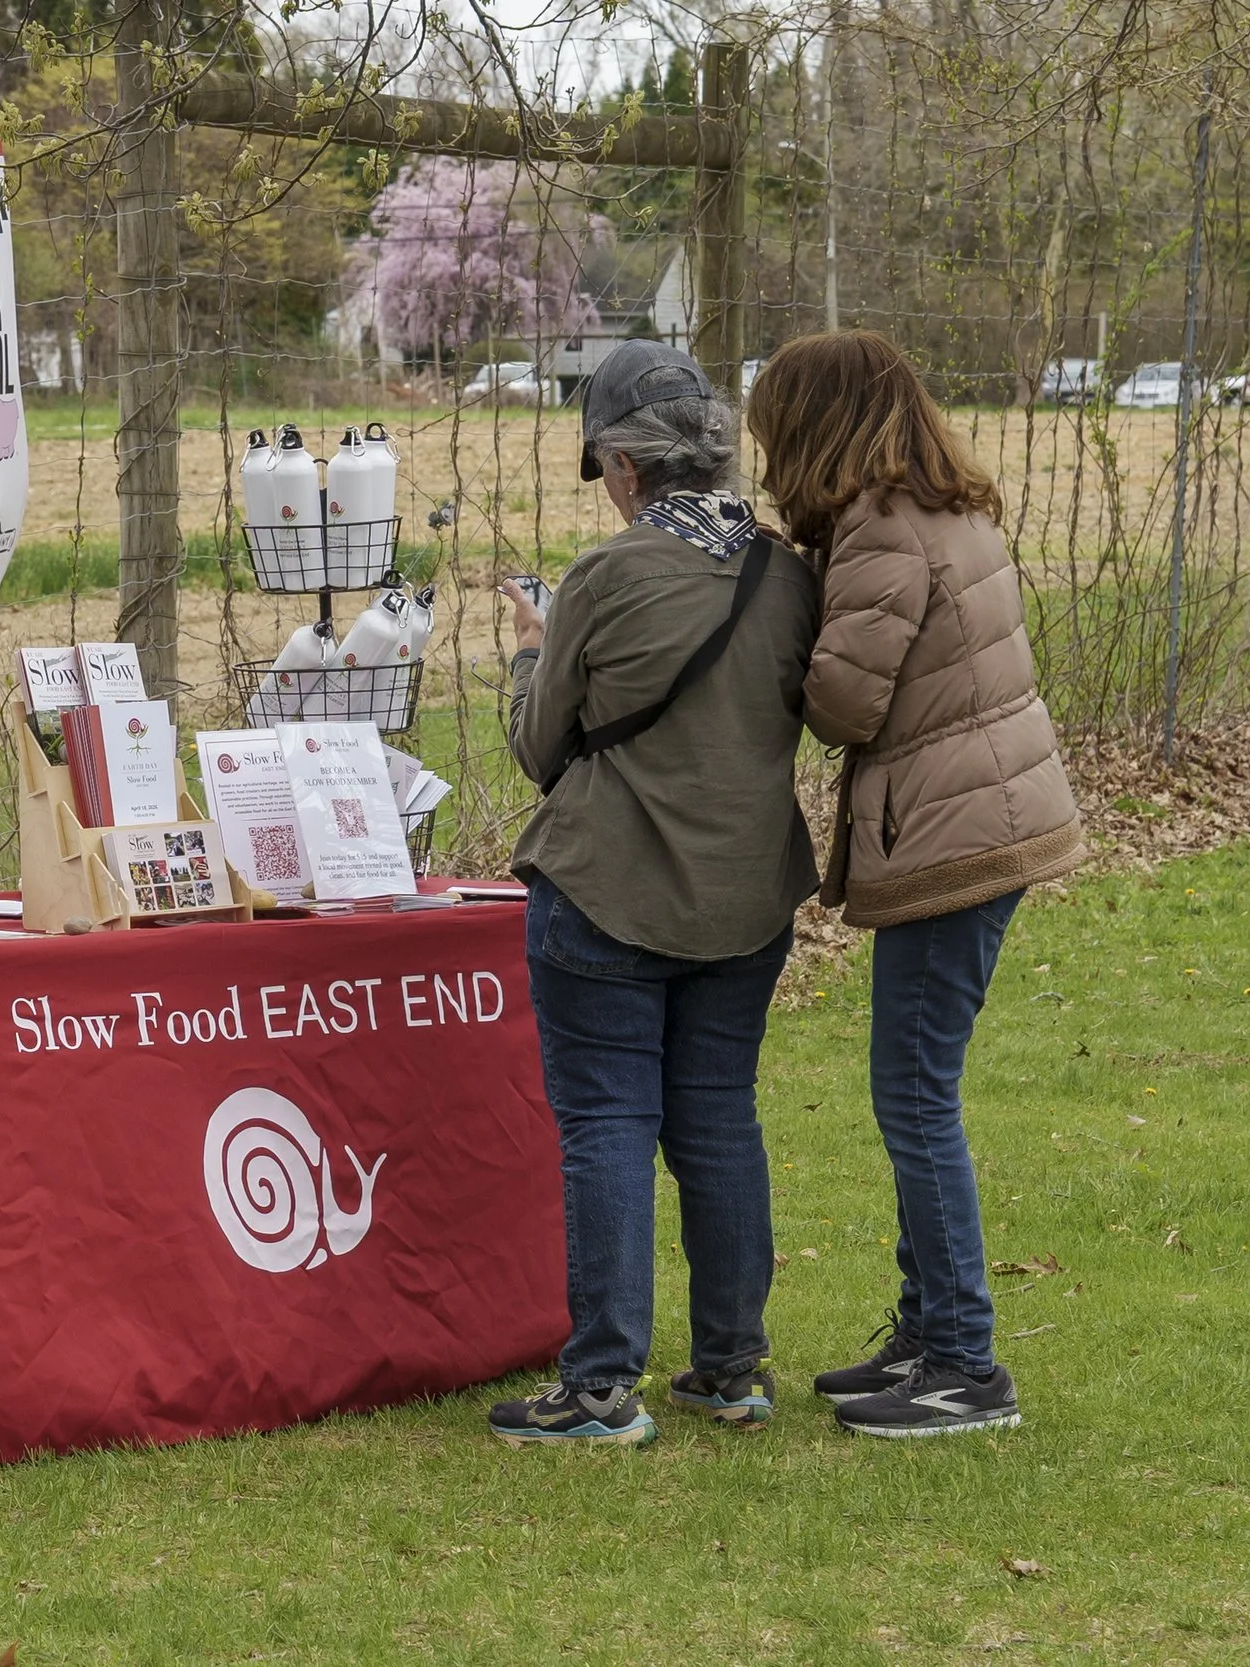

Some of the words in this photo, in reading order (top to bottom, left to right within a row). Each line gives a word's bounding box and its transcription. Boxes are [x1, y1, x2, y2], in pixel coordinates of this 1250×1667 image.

[28, 658, 80, 686] Slow
[88, 652, 136, 681] Slow
[243, 752, 270, 765] Slow
[320, 767, 350, 775] BECOME
[142, 774, 158, 783] Food
[303, 778, 325, 787] SLOW
[326, 778, 346, 786] FOOD
[346, 777, 378, 785] MEMBER
[129, 837, 154, 851] Slow
[332, 854, 347, 862] today
[11, 994, 120, 1054] Slow
[130, 984, 247, 1047] Food
[260, 977, 383, 1040] EAST
[400, 970, 504, 1028] END
